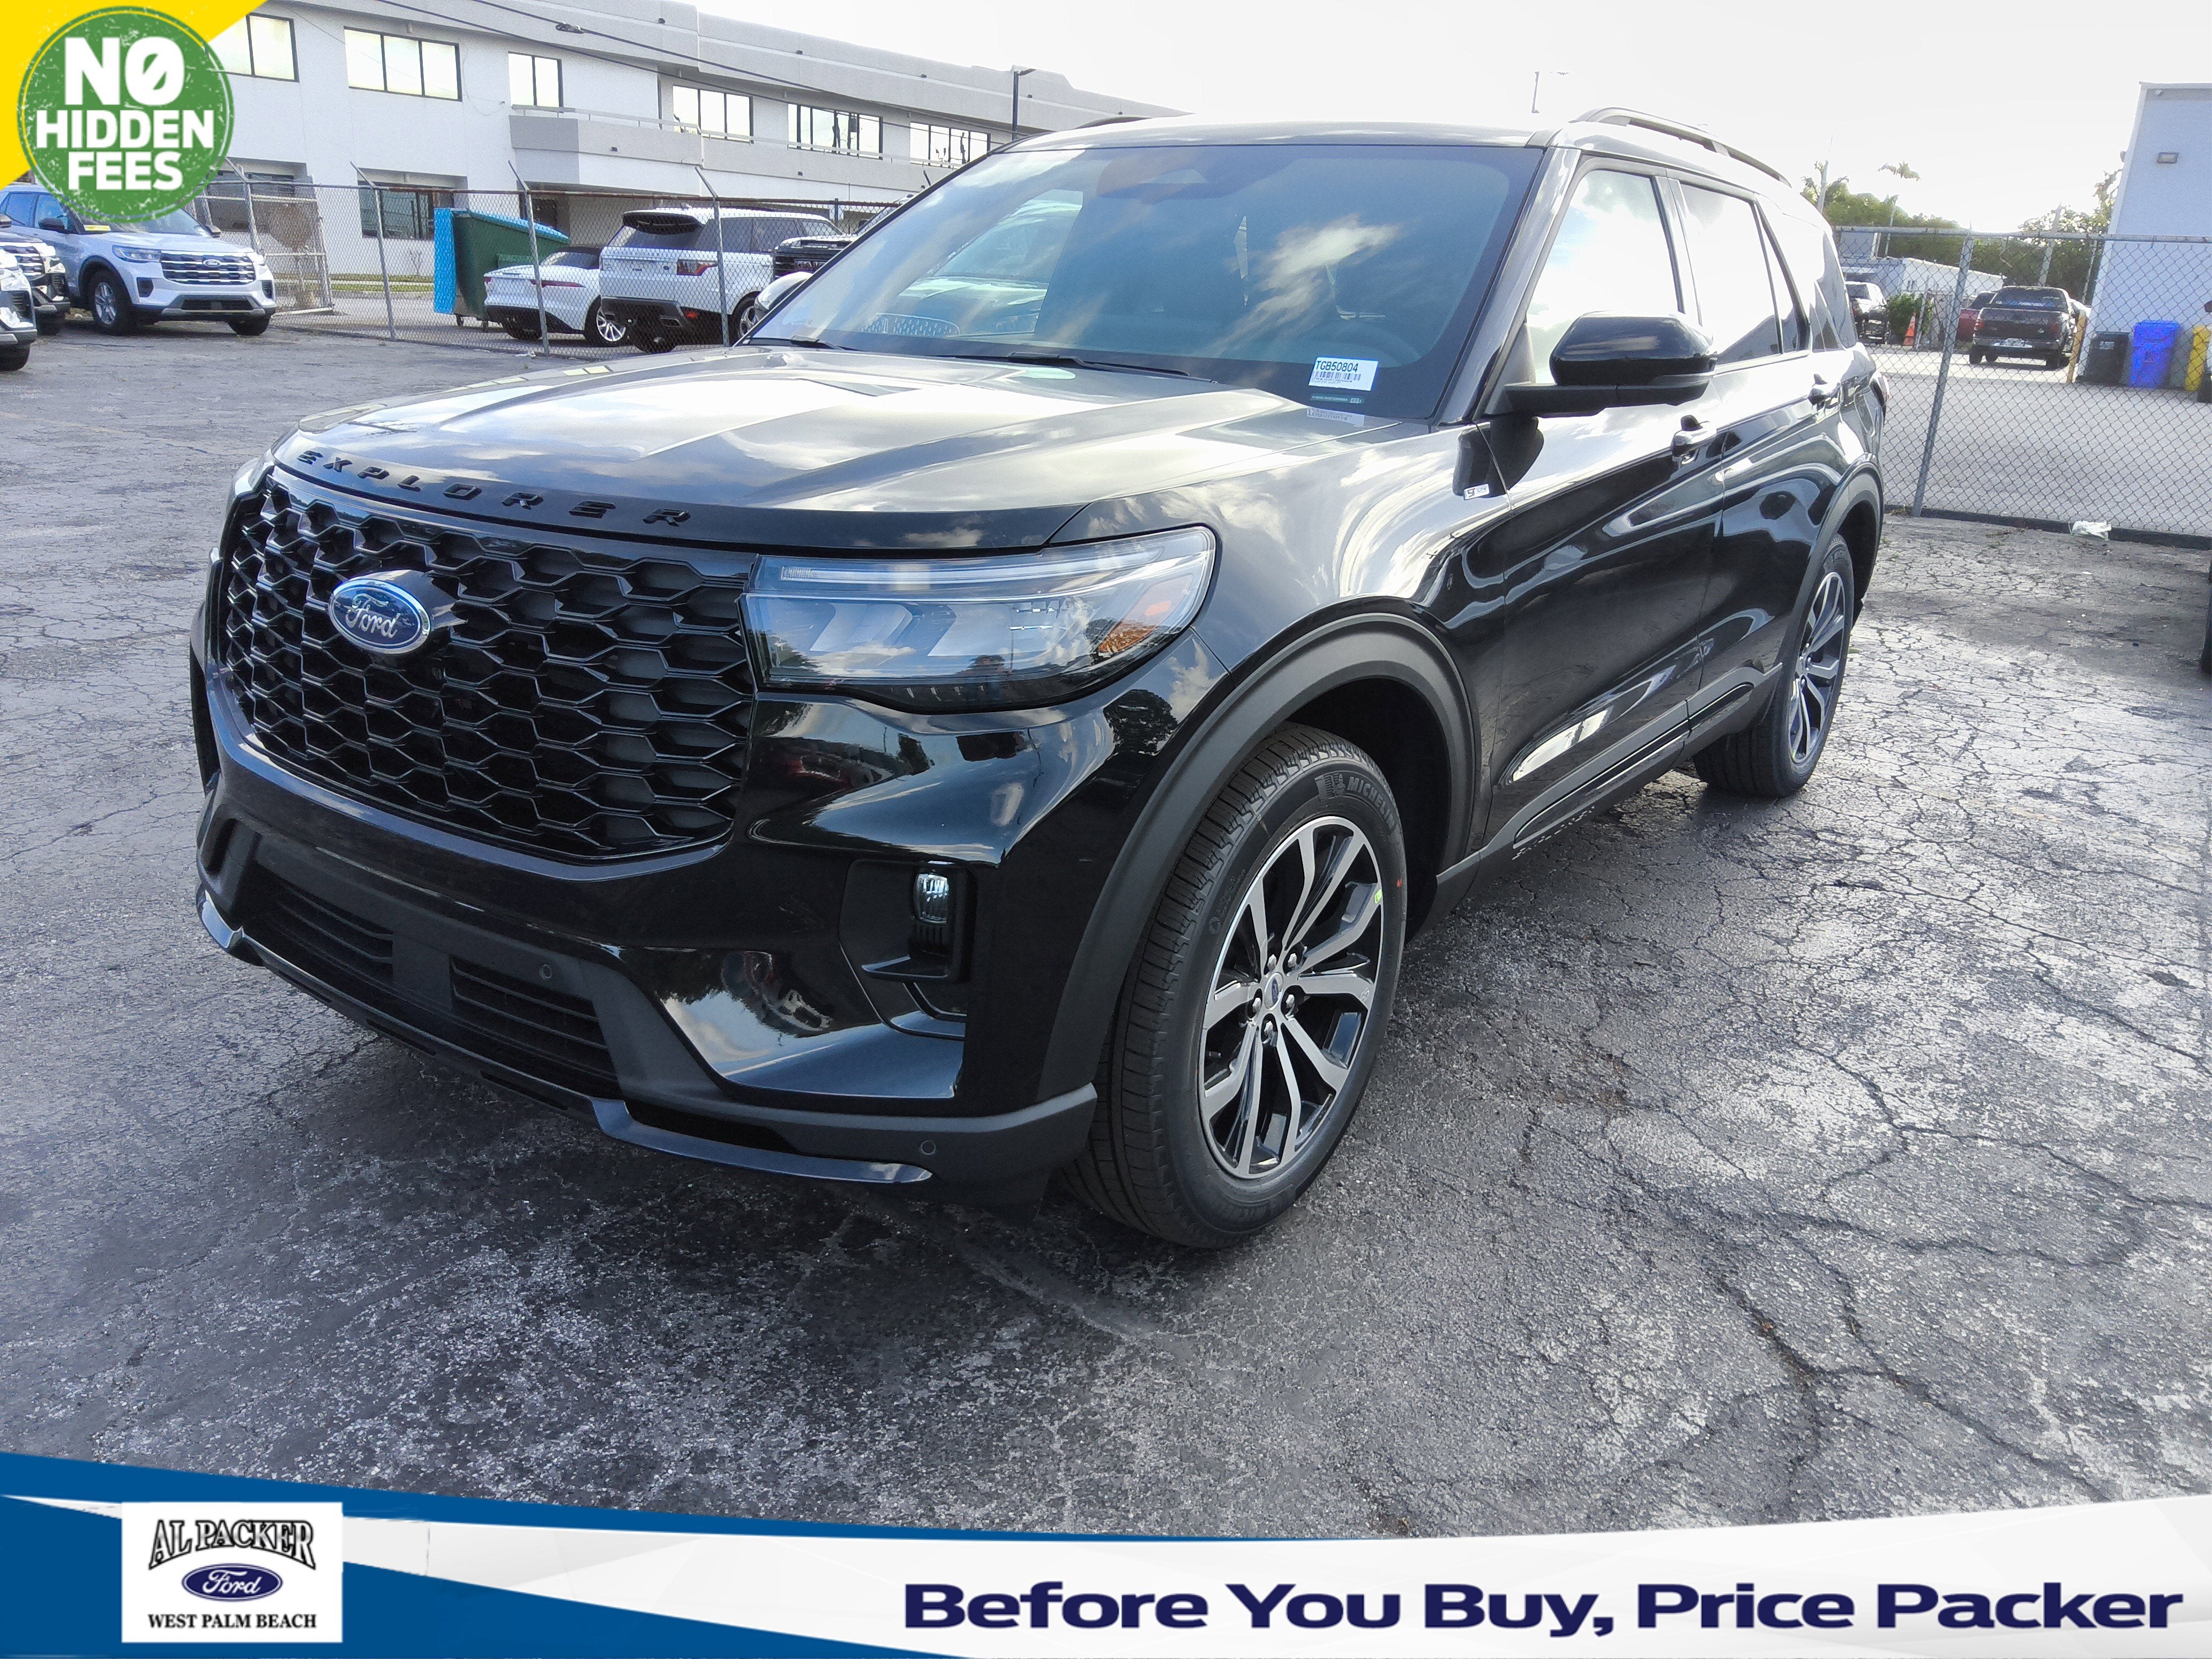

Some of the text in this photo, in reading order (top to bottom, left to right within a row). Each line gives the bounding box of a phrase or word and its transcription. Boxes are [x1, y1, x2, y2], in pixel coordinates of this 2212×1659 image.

[1316, 361, 1358, 372] TGB50804
[297, 450, 691, 527] EXPLORER
[346, 593, 399, 639] Ford
[1347, 776, 1395, 830] MICHELIN
